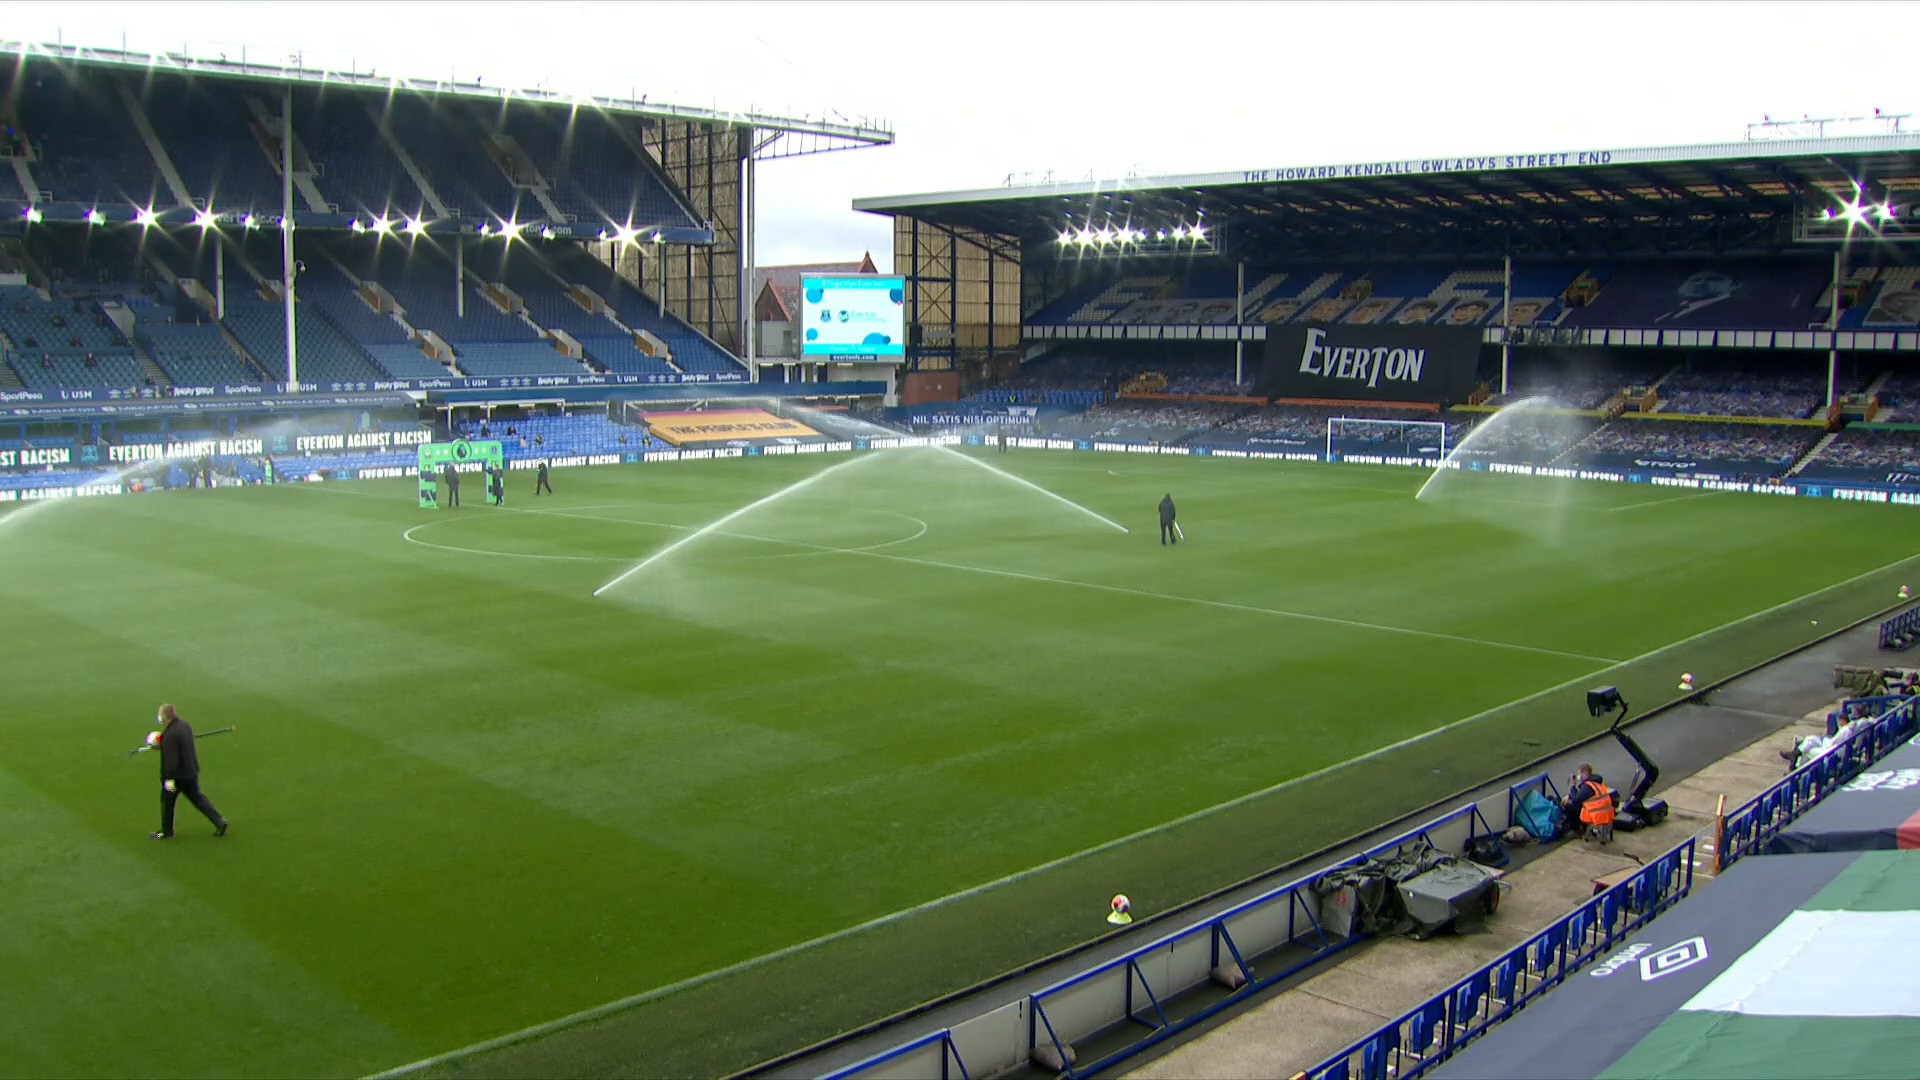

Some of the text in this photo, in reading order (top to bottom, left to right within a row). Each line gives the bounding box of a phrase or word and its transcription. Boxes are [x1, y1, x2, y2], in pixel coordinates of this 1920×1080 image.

[1243, 150, 1612, 182] THE HOWARD KENDALL GWLADYS STREET END
[1299, 327, 1425, 388] EVERTON
[912, 414, 1030, 425] NIL SATIS NISI OPTIMUM
[296, 430, 432, 451] EVERTON AGAINST RACISM
[1047, 439, 1074, 449] RACISM
[20, 448, 70, 465] RACISM
[109, 439, 263, 461] EVERTON AGAINST RACISM
[551, 456, 588, 468] AGAINST
[589, 453, 621, 465] RACISM
[1425, 459, 1460, 470] RAISM
